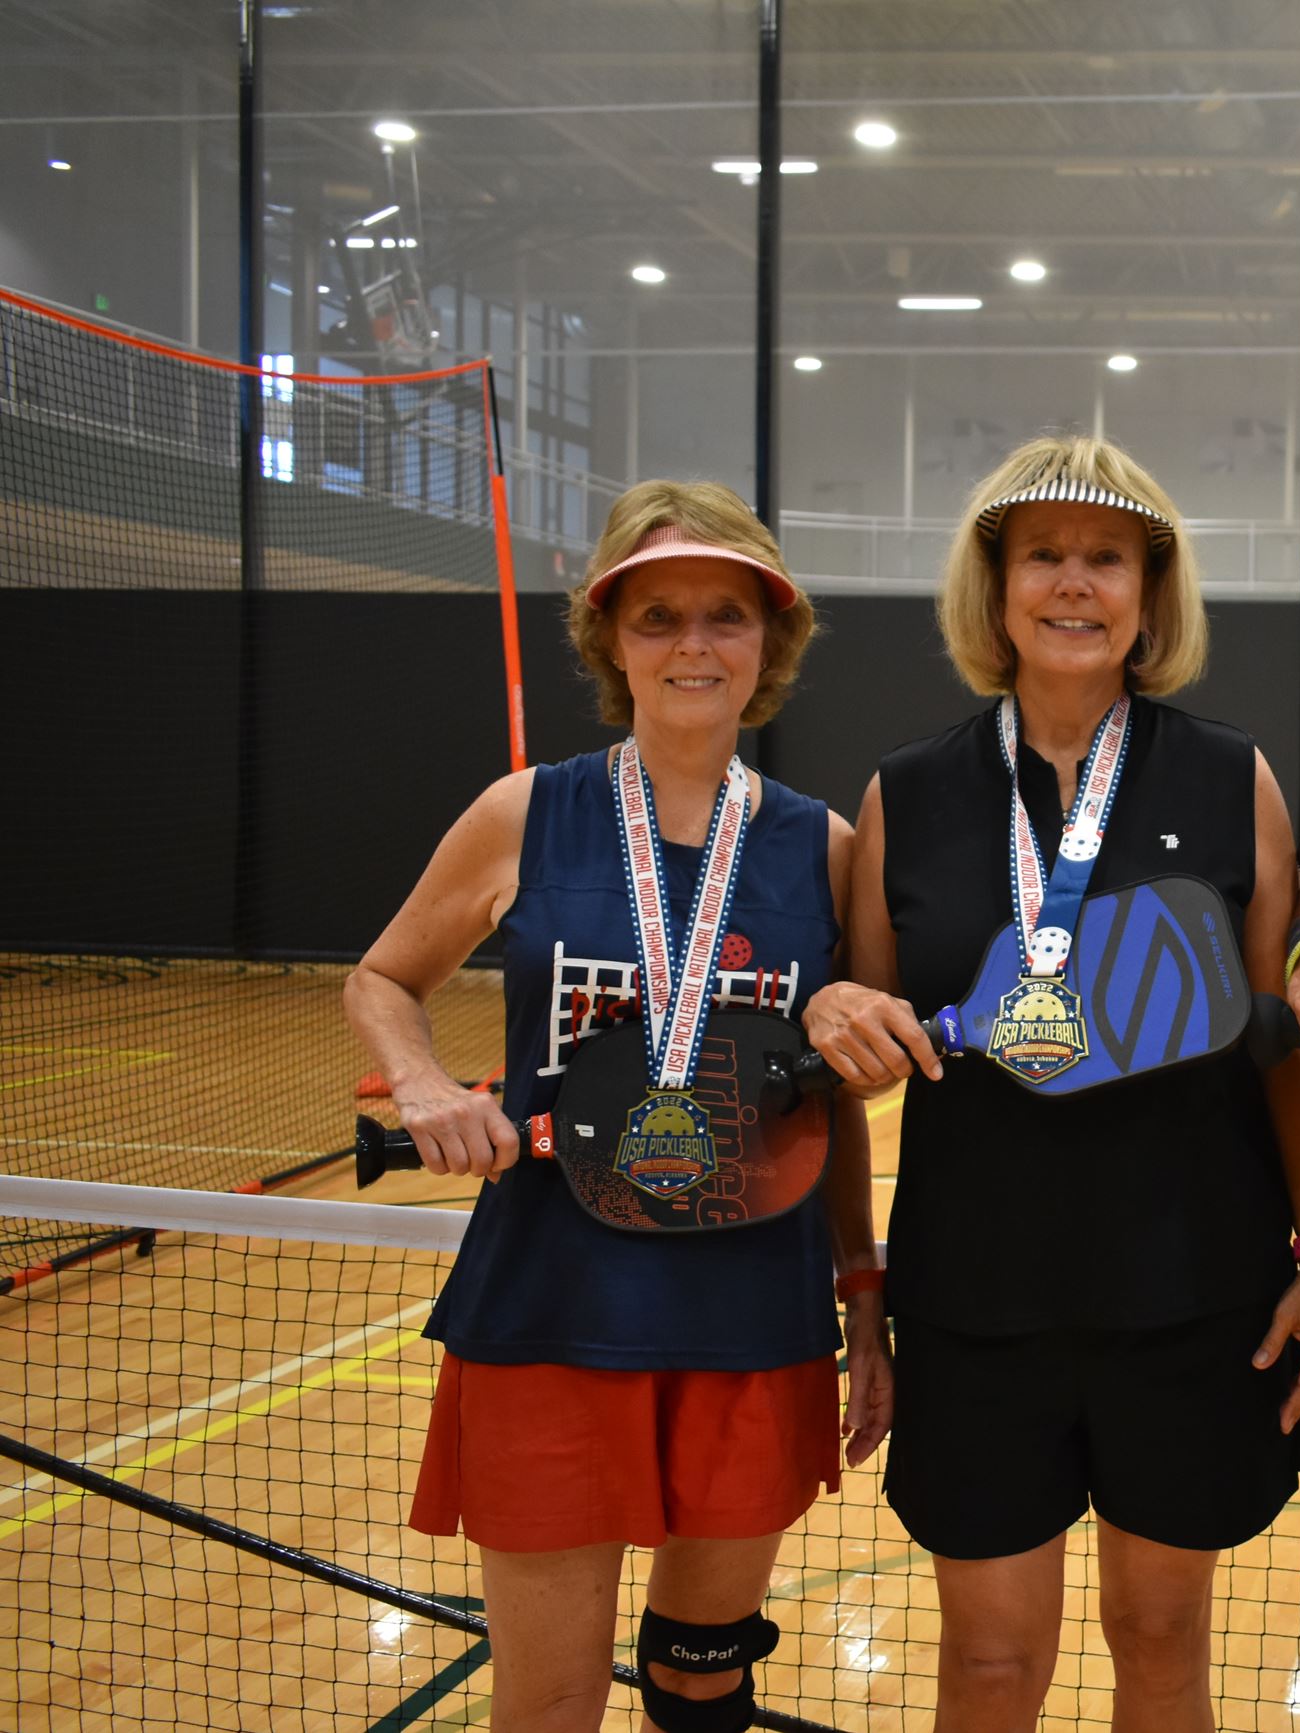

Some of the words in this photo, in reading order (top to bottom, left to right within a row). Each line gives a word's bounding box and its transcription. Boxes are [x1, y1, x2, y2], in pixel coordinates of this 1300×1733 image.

[1096, 727, 1121, 776] PICKLEBALL
[622, 764, 645, 822] PICKLEBALL
[1089, 776, 1108, 795] USA
[630, 823, 653, 876] NATIONAL
[709, 799, 741, 884] CHAMPIONSHIPS
[1021, 853, 1038, 889] INDOOR
[638, 877, 659, 919] INDOOR
[699, 883, 724, 925] INDOOR
[643, 921, 669, 1015] CHAMPIONSHIPS
[687, 928, 714, 980] NATIONAL
[1027, 983, 1053, 992] 2022
[672, 983, 702, 1047] PICKLEBALL
[993, 1022, 1019, 1049] USA
[1020, 1022, 1084, 1049] PICKLEBALL
[666, 1047, 688, 1073] USA
[656, 1097, 682, 1106] 2022
[620, 1137, 646, 1165] USA
[648, 1137, 713, 1166] PICKLEBALL
